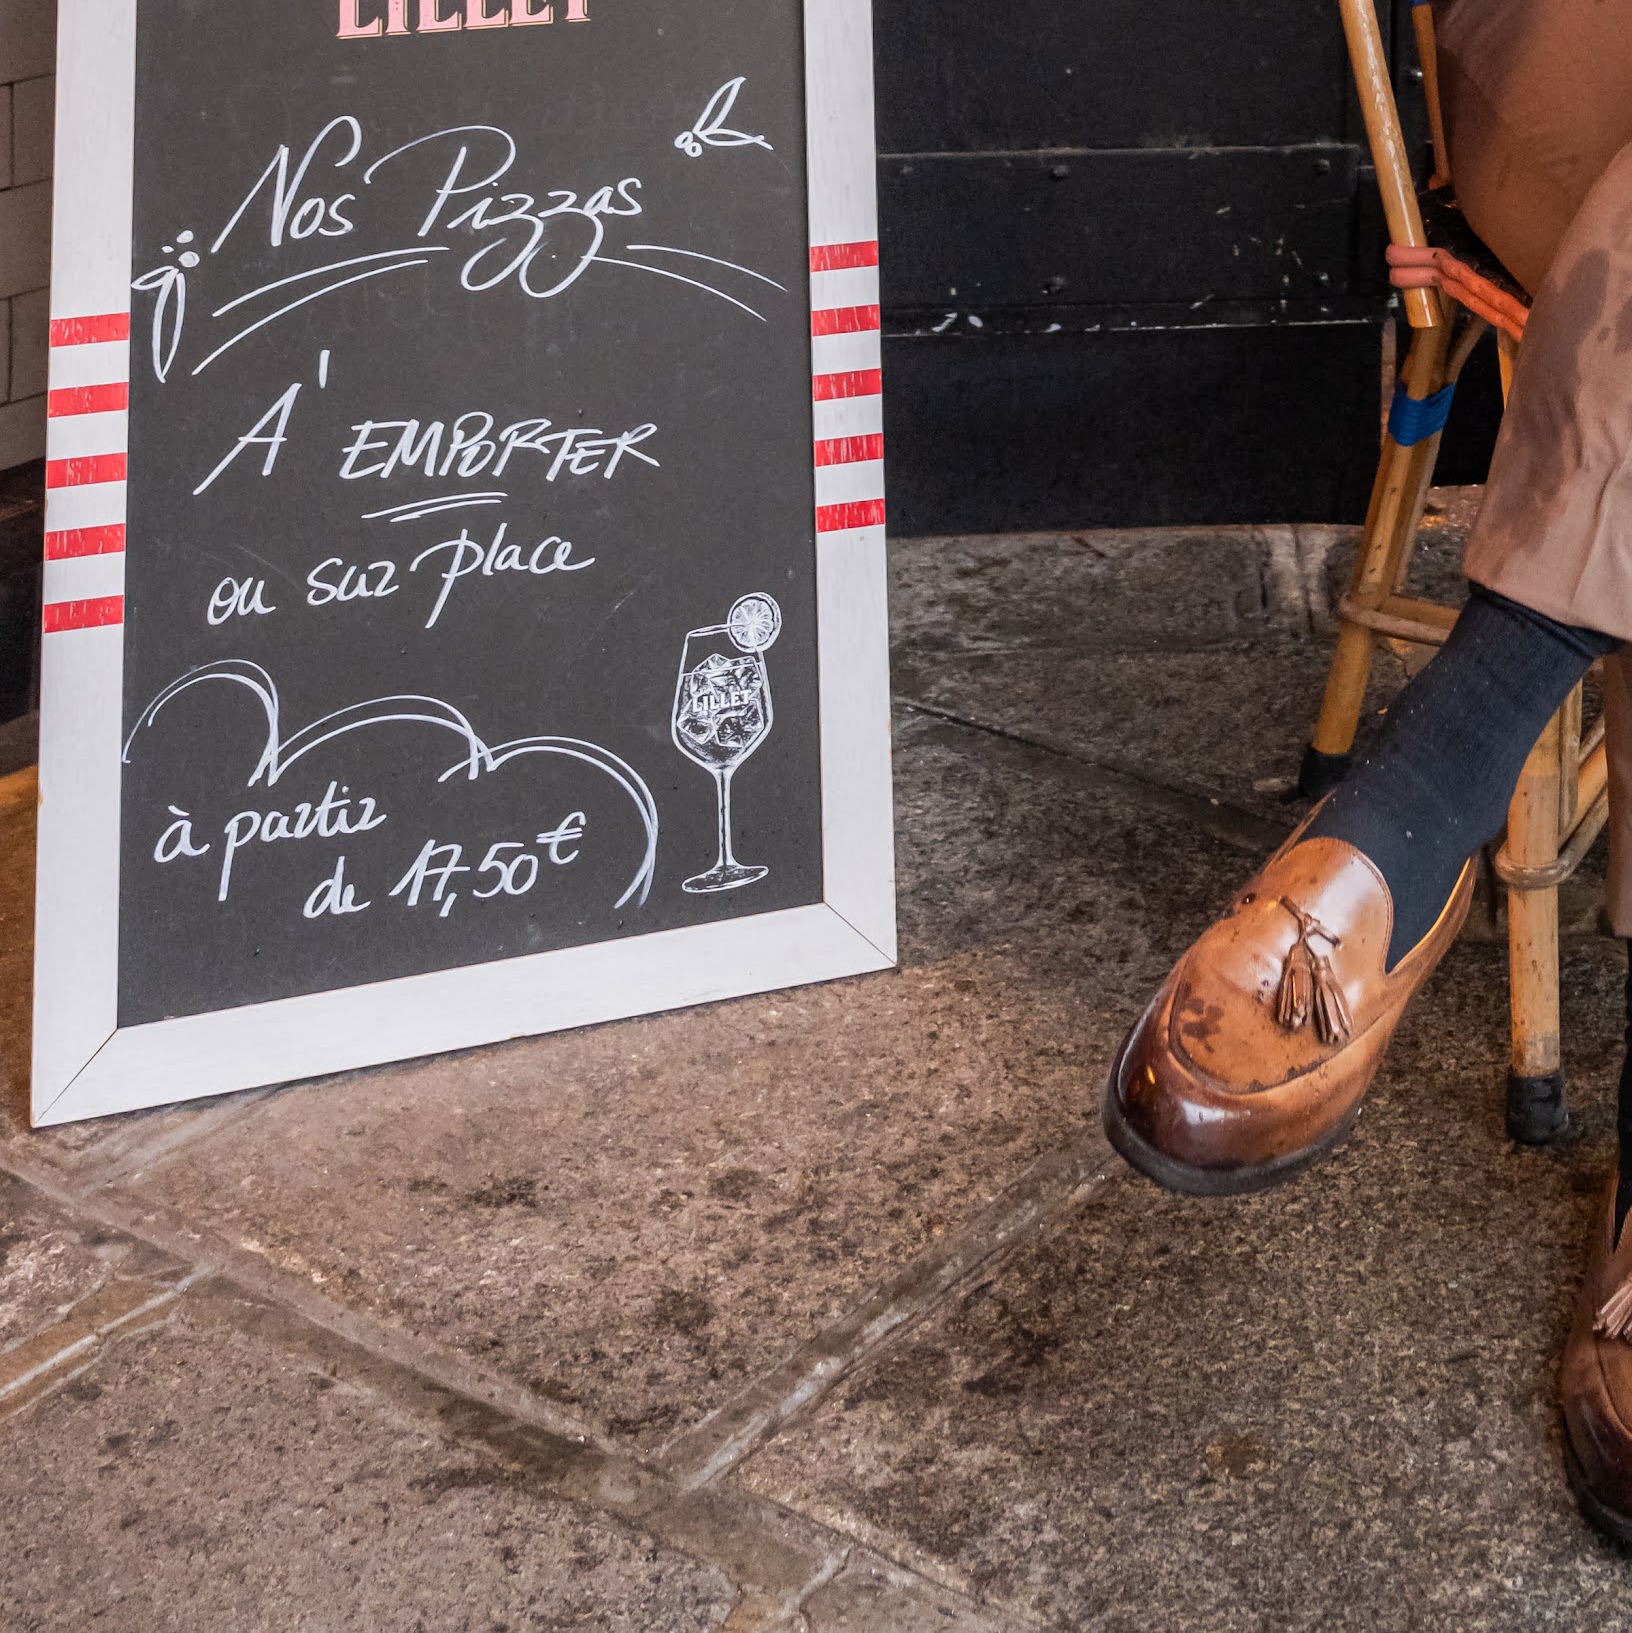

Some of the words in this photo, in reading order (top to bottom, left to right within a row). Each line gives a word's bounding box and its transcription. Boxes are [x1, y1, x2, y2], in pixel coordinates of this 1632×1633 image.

[211, 116, 363, 253] Nos
[363, 125, 644, 298] Pizzas
[339, 411, 661, 483] EMPORTER
[207, 577, 277, 626] ou
[409, 523, 596, 629] place
[692, 689, 752, 713] LILLET
[153, 804, 211, 863] à
[218, 781, 388, 902] partir
[303, 856, 372, 919] de
